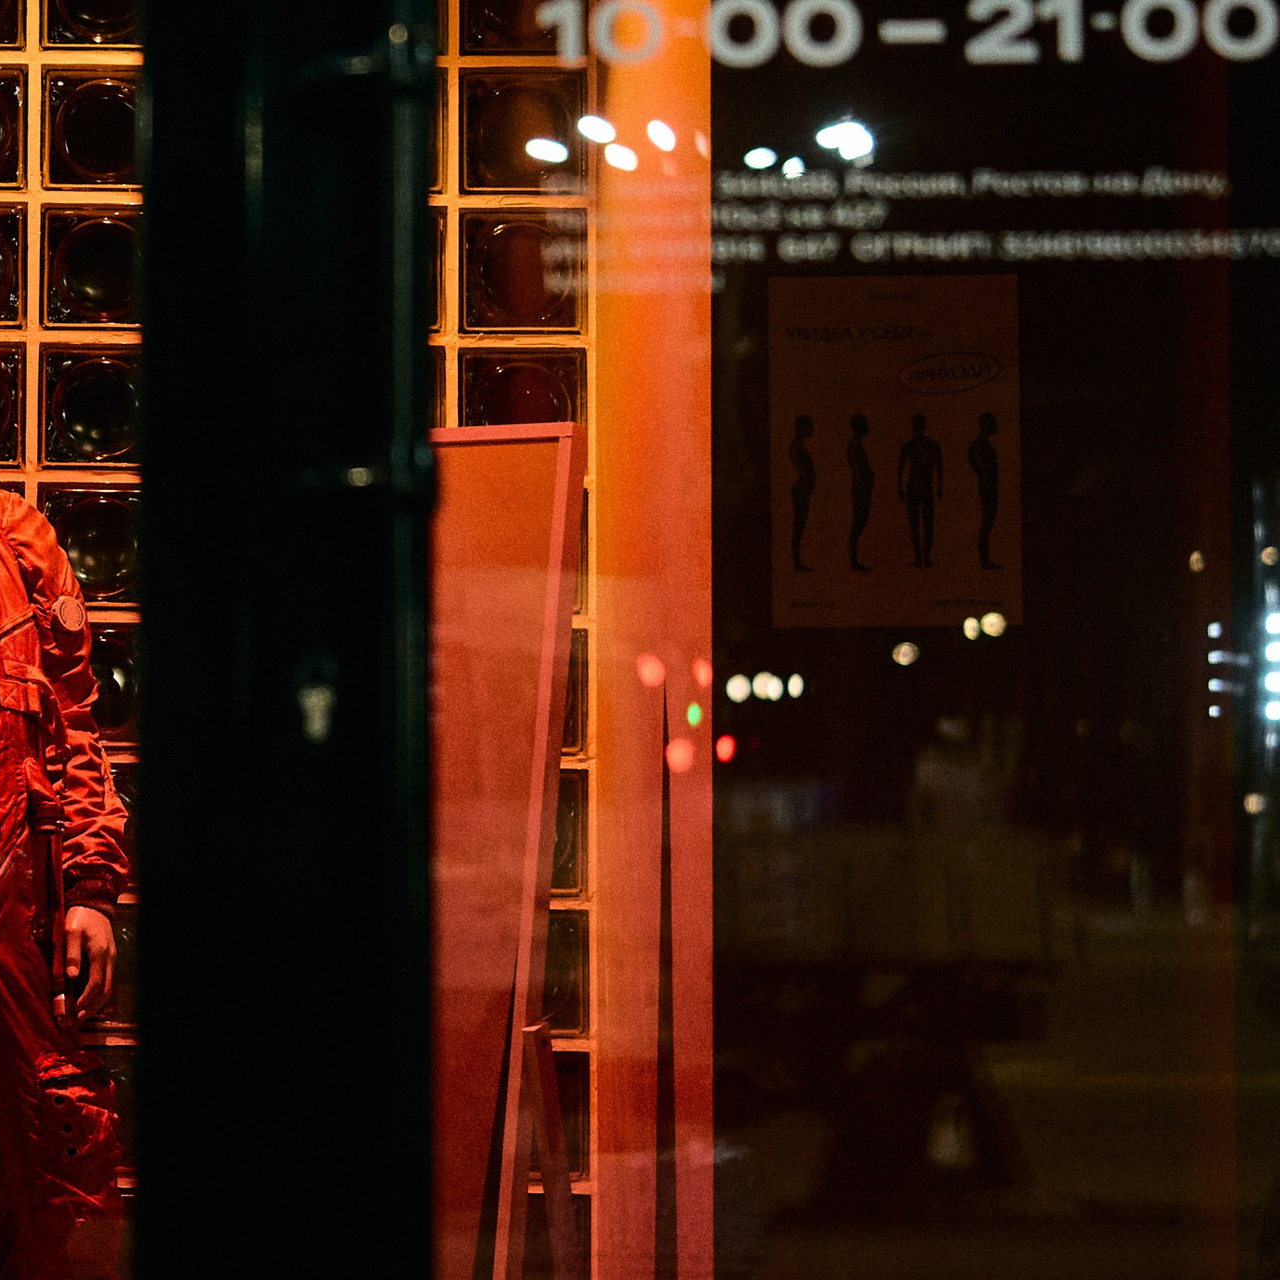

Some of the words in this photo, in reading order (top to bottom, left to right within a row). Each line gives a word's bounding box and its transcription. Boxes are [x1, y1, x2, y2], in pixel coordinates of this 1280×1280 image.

[786, 326, 853, 341] УВИДЕЛ
[858, 326, 869, 340] У
[870, 326, 915, 341] СЕБЯ
[909, 362, 992, 384] ПРИХОДИ
